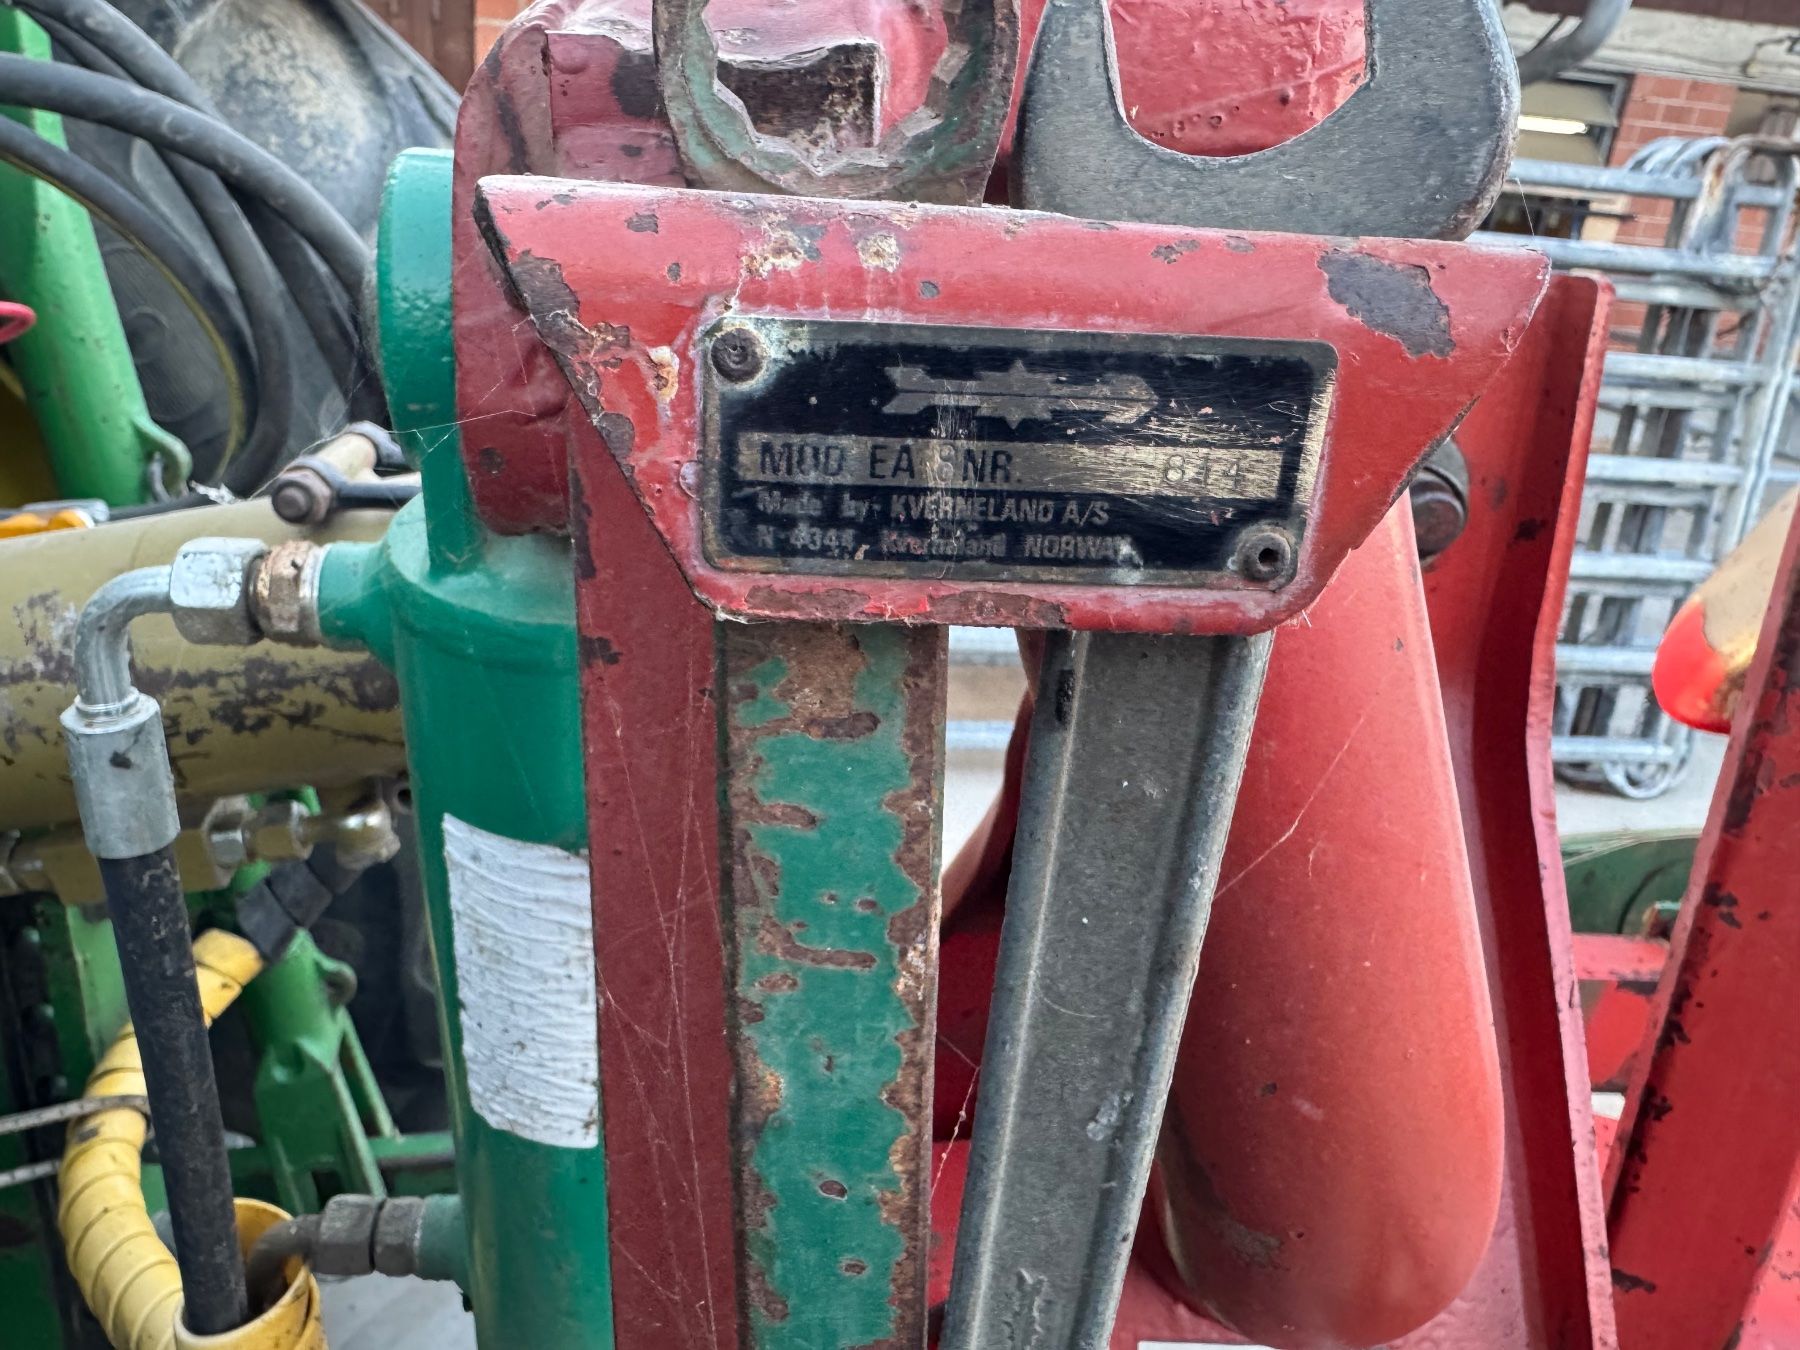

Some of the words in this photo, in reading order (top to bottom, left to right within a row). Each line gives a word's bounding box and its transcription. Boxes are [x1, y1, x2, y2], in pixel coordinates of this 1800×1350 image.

[868, 444, 915, 480] EA
[890, 493, 1055, 524] KVERNELAND
[1061, 499, 1111, 527] A/S
